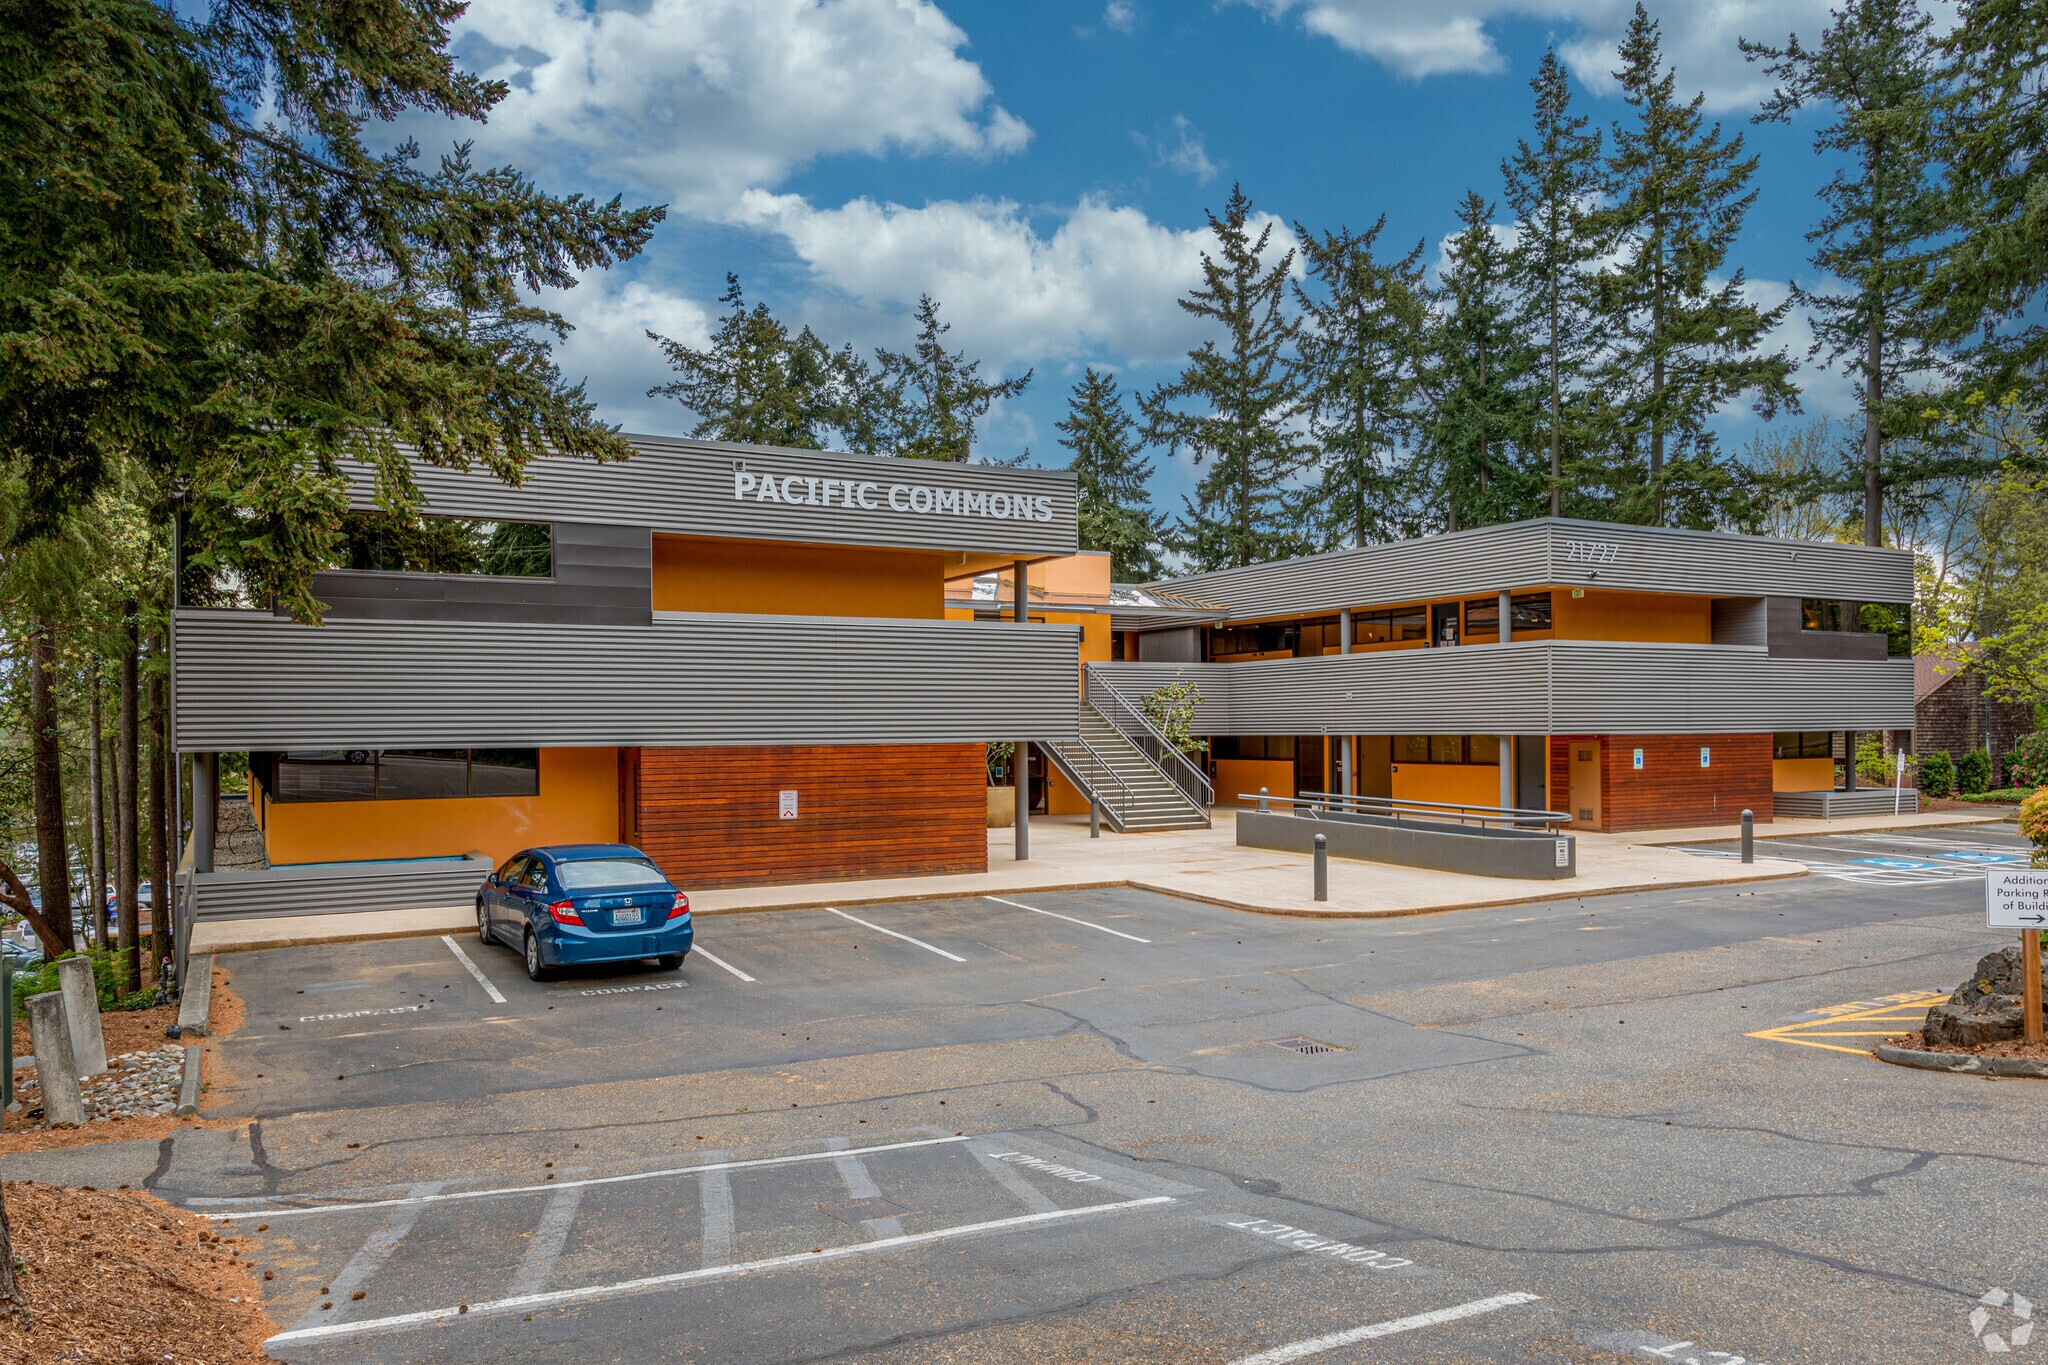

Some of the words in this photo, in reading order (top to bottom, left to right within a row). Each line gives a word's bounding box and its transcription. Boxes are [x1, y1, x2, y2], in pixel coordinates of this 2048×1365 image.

[734, 471, 878, 510] PACIFIC
[888, 484, 1053, 522] COMMONS
[1566, 540, 1620, 564] 21727
[1997, 888, 2039, 900] Parking
[2003, 901, 2014, 910] of
[581, 982, 683, 996] COMPACT
[1227, 1219, 1414, 1269] COMPACT
